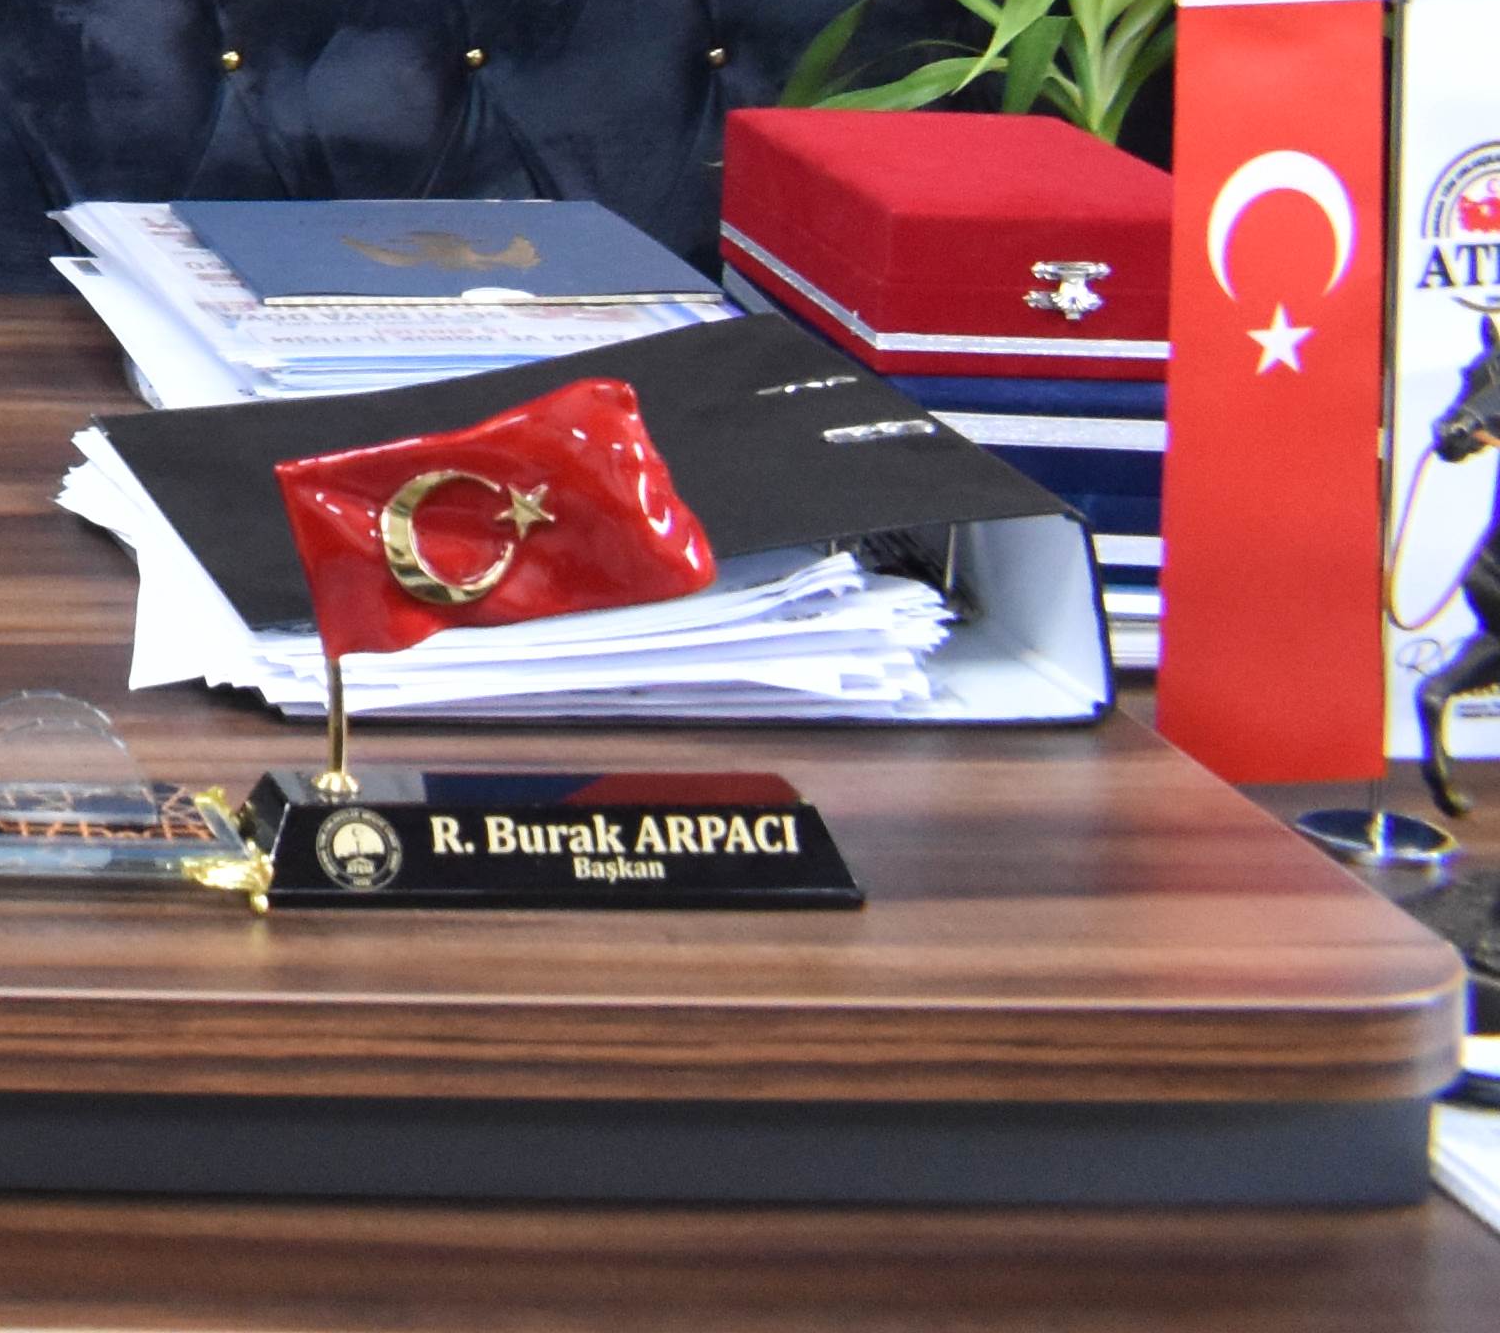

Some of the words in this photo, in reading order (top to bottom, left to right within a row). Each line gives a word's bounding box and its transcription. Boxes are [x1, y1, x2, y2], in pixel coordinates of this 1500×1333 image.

[429, 815, 476, 854] R.
[485, 814, 626, 855] Burak
[635, 815, 800, 855] ARPACI
[574, 856, 667, 885] Başkan
